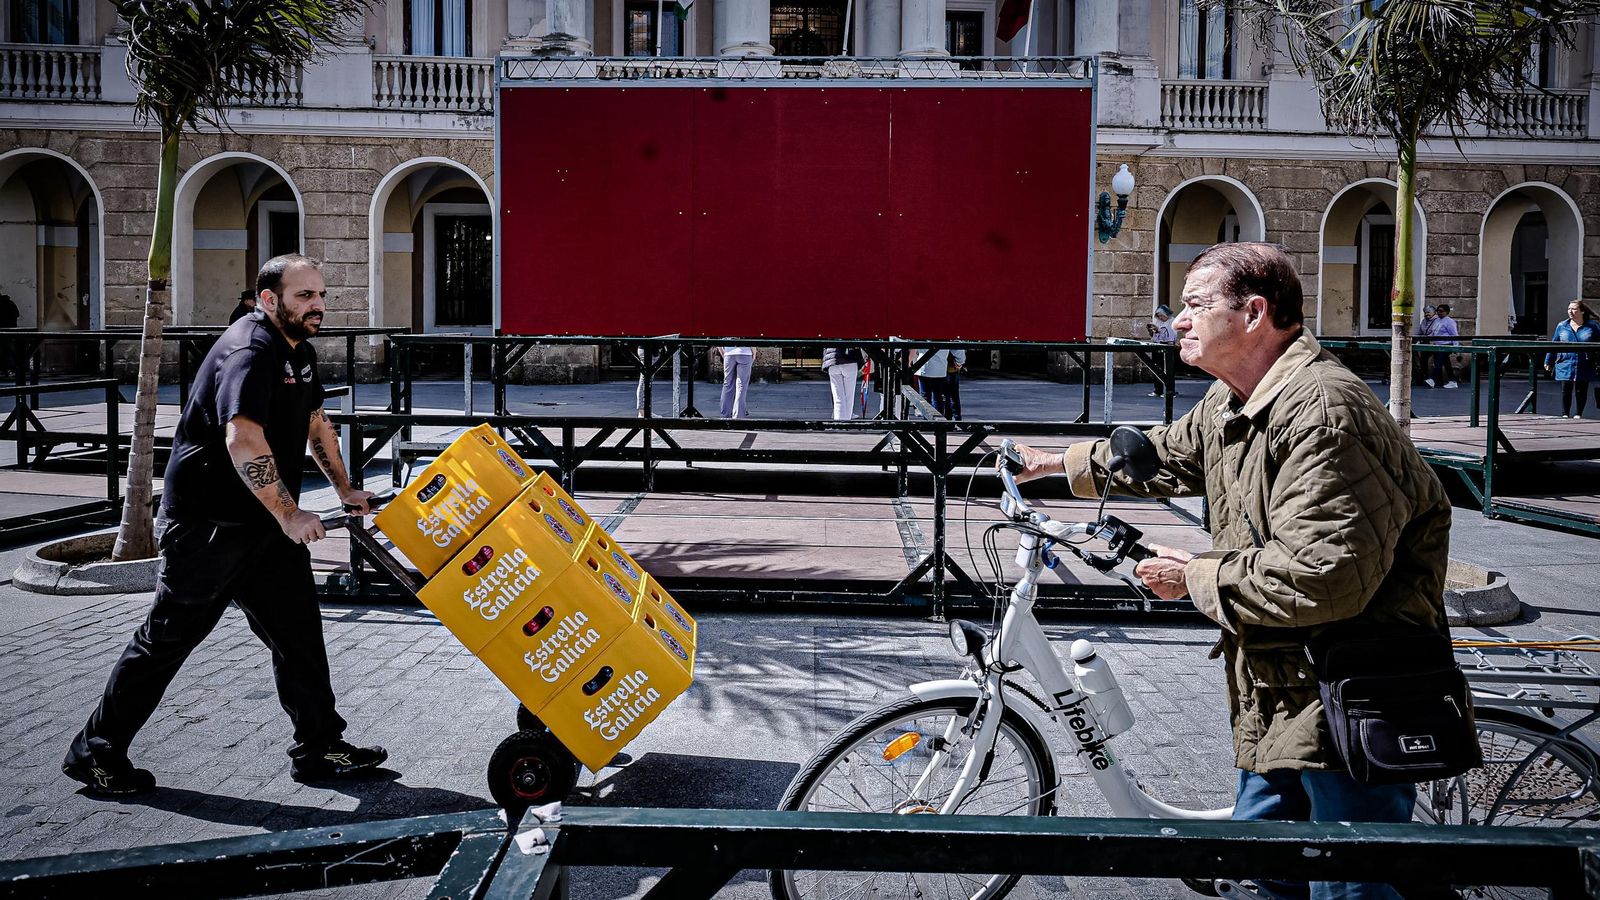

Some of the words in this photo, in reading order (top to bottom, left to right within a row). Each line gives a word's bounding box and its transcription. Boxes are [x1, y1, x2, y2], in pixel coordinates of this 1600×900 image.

[417, 479, 478, 537] Estrella
[432, 496, 491, 548] Galicia
[463, 548, 528, 611] Estrella
[480, 565, 540, 621] Galicia
[523, 611, 589, 673] Estrella
[540, 628, 601, 683] Galicia
[583, 670, 649, 731] Estrella
[600, 687, 661, 741] Galicia
[1053, 688, 1110, 771] Lifebike
